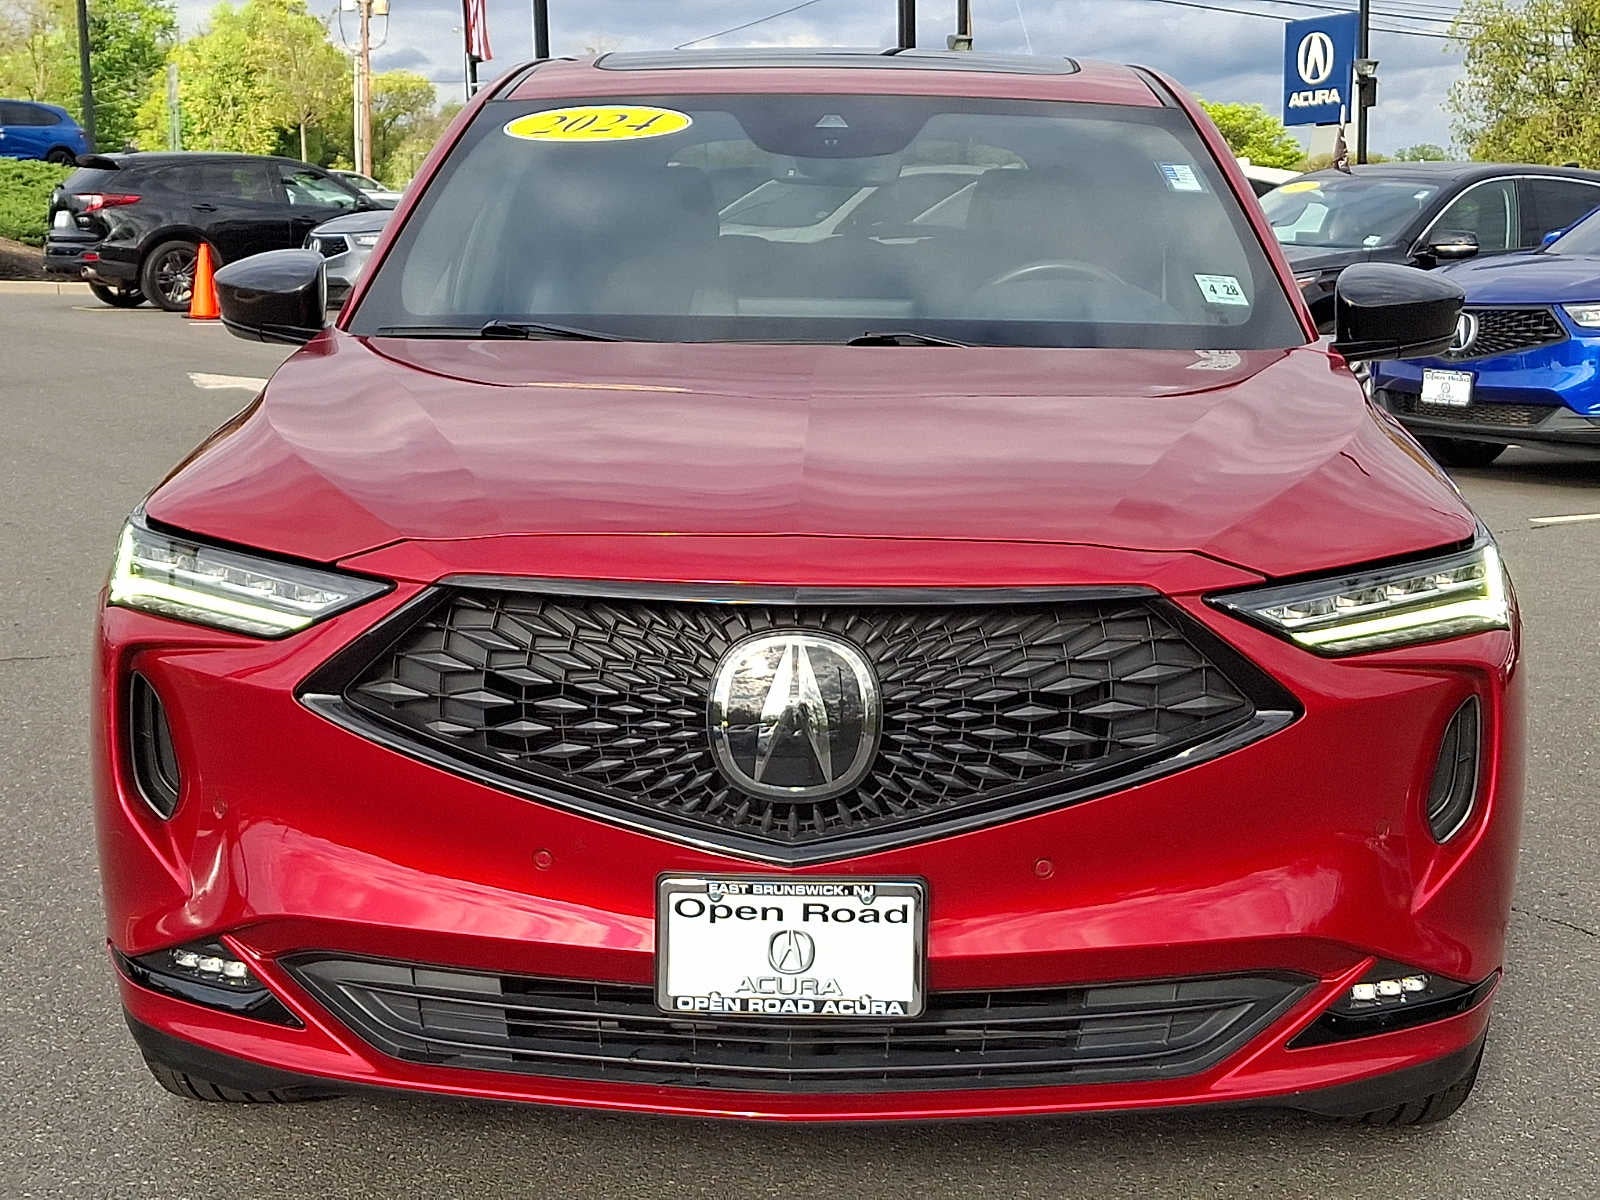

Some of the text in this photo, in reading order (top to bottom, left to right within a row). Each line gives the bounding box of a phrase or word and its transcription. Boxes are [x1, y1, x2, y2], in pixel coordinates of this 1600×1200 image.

[1288, 88, 1340, 107] ACURA
[530, 113, 665, 135] 2024
[1222, 284, 1239, 296] 28
[708, 883, 749, 896] EAST
[853, 885, 875, 897] NJ
[674, 898, 908, 924] Open Road
[735, 975, 844, 997] ACURA
[676, 996, 904, 1015] OPEN ROAD ACURA
